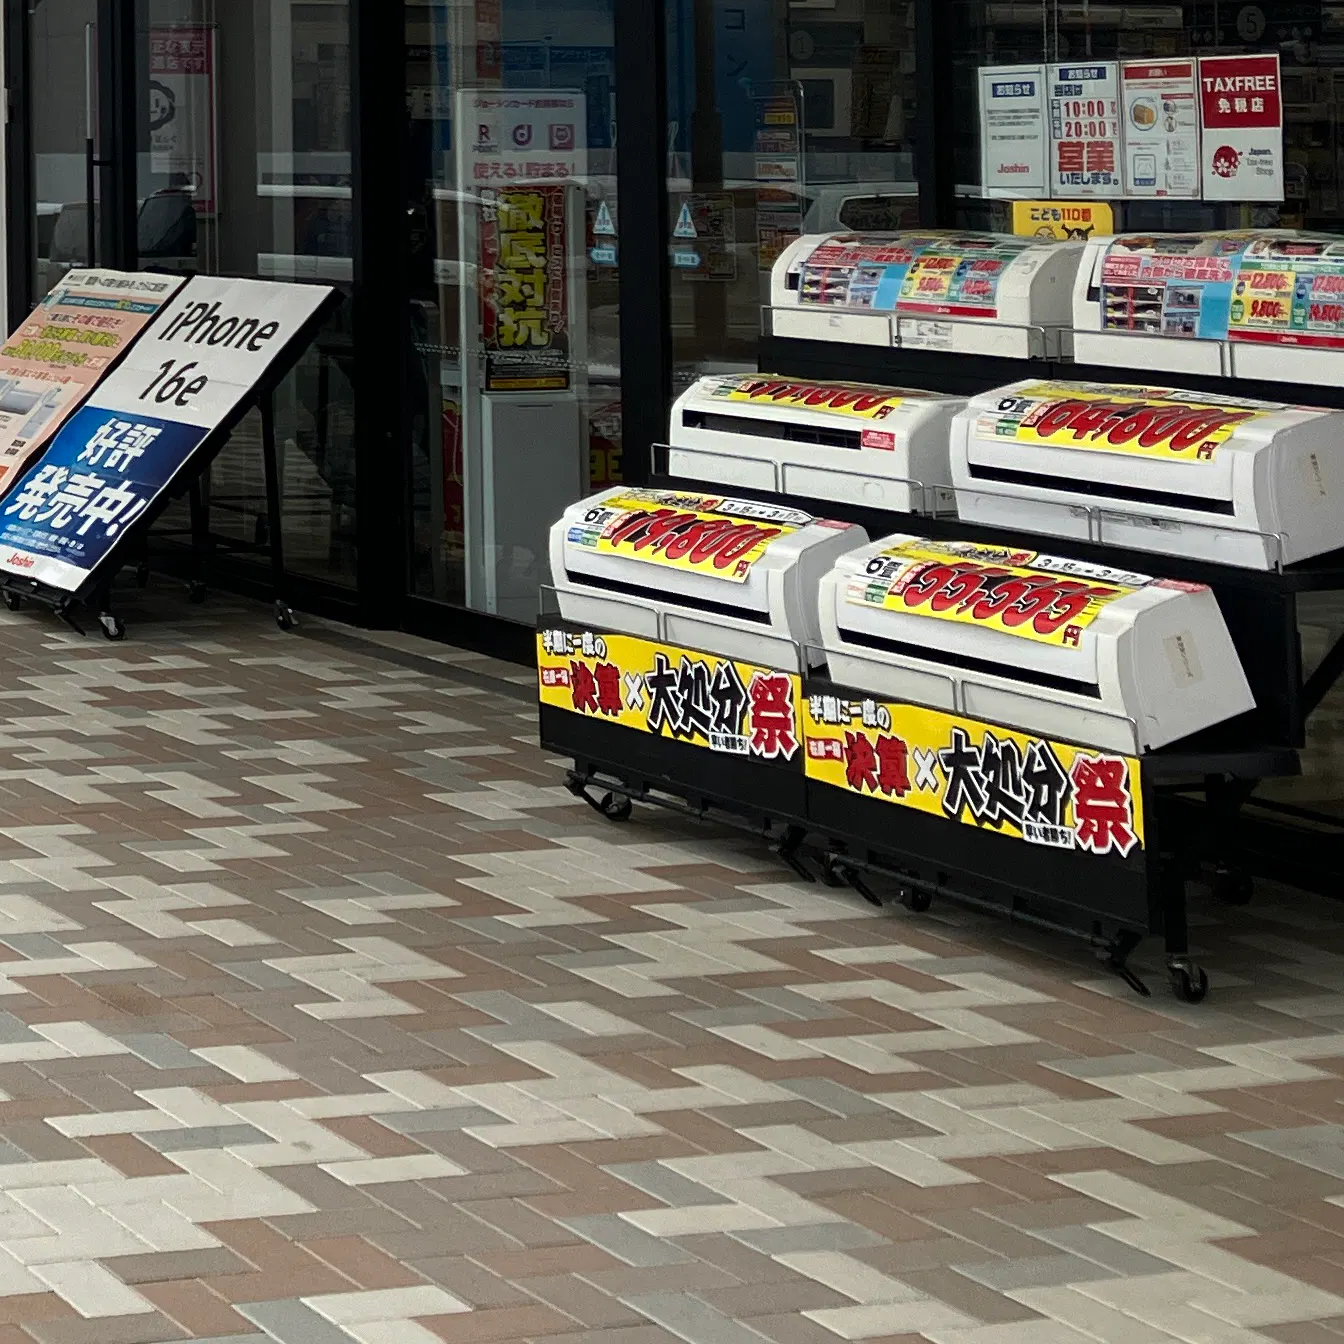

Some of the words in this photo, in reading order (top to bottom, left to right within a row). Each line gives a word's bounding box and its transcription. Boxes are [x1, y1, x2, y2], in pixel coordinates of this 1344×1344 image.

[997, 83, 1030, 97] お知らせ
[1203, 76, 1276, 93] TAXFREE
[1064, 100, 1105, 118] 10:00
[1065, 121, 1107, 138] 20:00
[1058, 141, 1115, 173] 営業
[997, 163, 1030, 174] Joshin
[157, 301, 280, 354] iPhone
[137, 360, 209, 408] 16e
[77, 416, 164, 473] 好評
